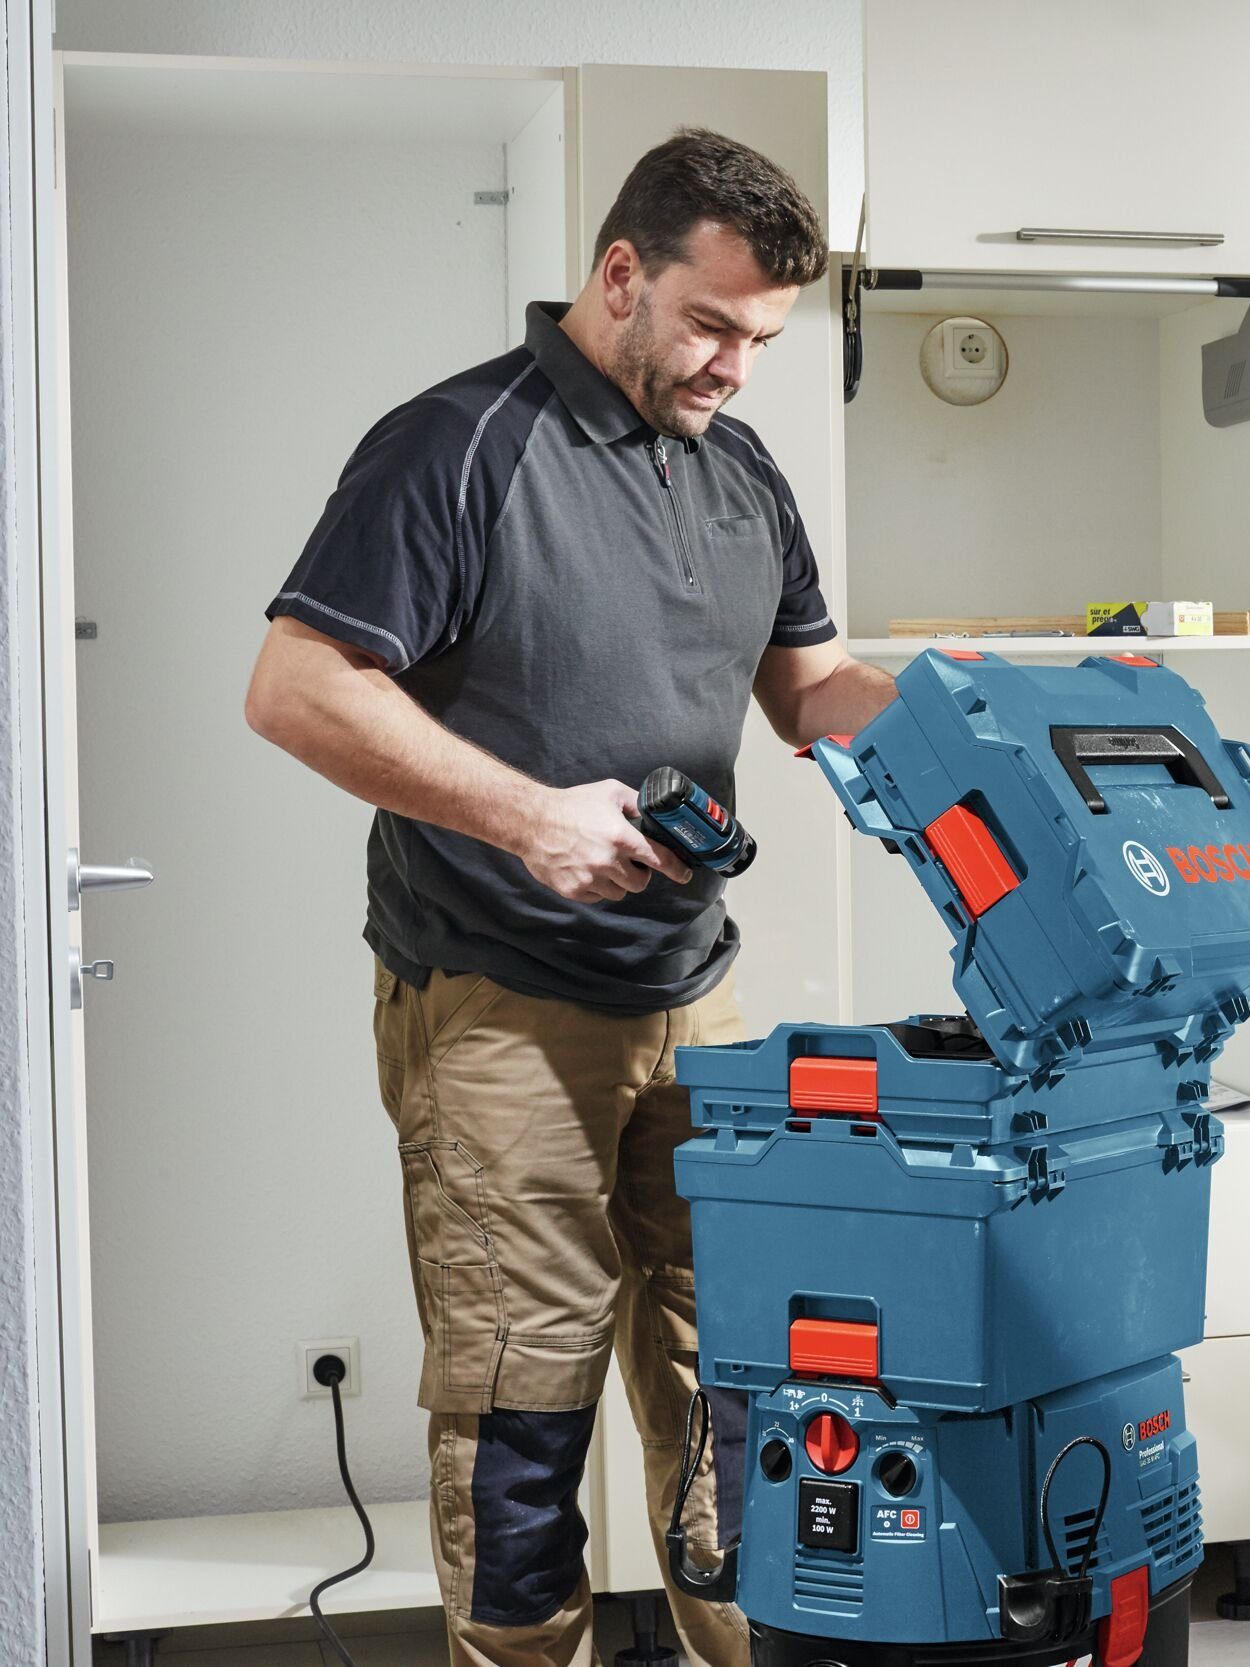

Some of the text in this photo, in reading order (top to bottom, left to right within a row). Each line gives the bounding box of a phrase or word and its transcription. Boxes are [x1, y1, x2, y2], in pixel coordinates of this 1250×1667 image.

[854, 1408, 861, 1417] 1
[1138, 1410, 1171, 1441] BOSCH
[1139, 1440, 1165, 1459] Professional
[815, 1497, 832, 1505] max.
[811, 1505, 837, 1515] 2200 W
[877, 1510, 897, 1519] AFC
[815, 1516, 831, 1524] min.
[812, 1524, 834, 1534] 100 W
